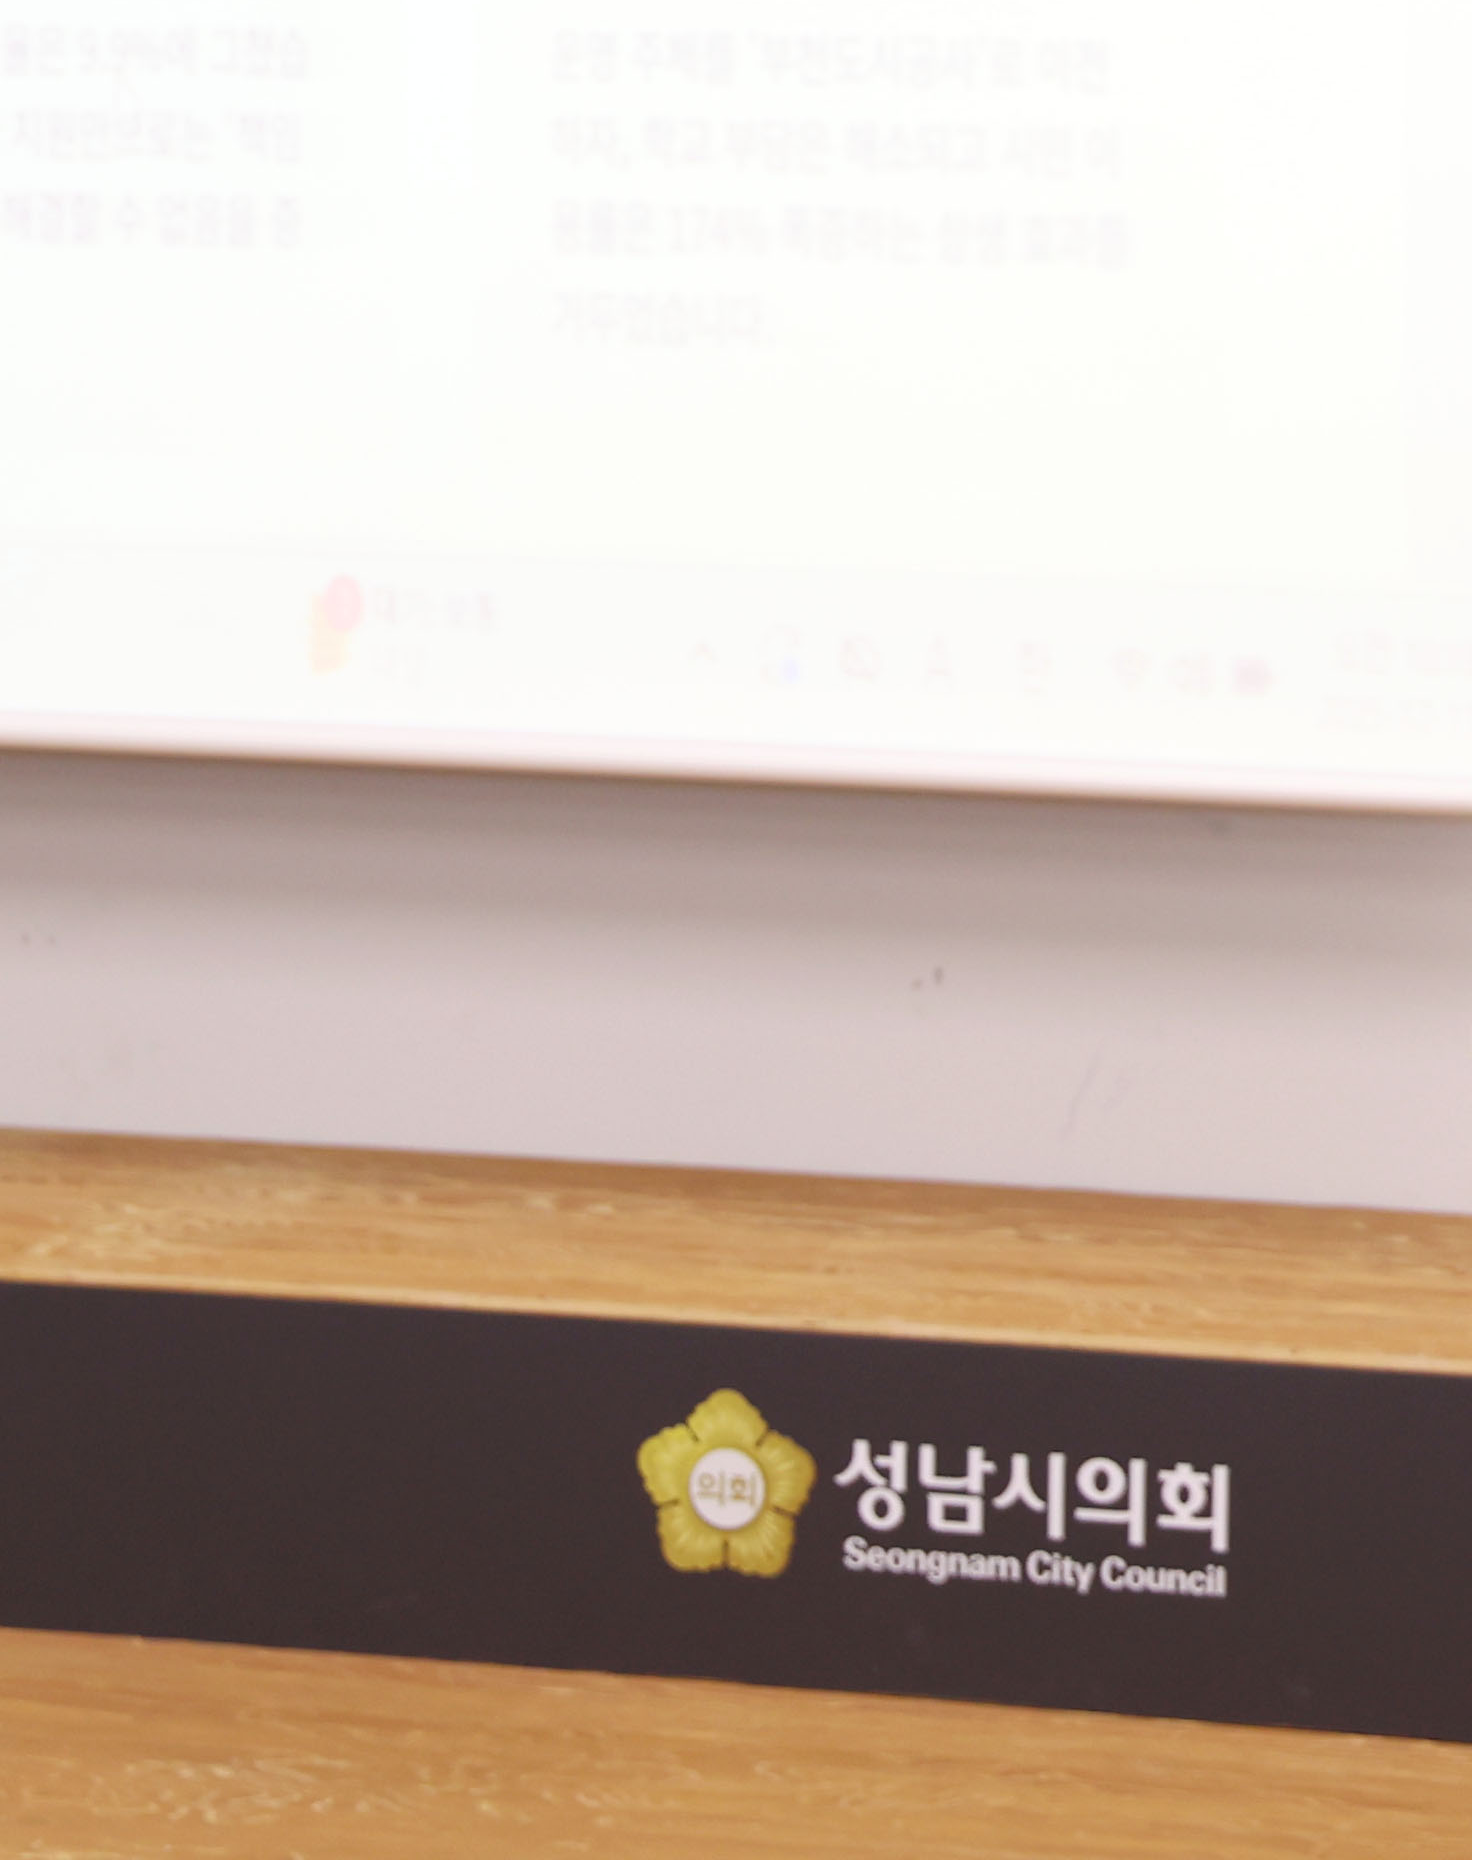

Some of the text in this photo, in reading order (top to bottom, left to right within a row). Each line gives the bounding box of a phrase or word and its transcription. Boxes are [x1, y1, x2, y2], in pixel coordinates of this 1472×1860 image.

[697, 1469, 760, 1509] 의회
[833, 1438, 1230, 1553] 성남시의회
[842, 1535, 1227, 1597] Seongnam City Council
